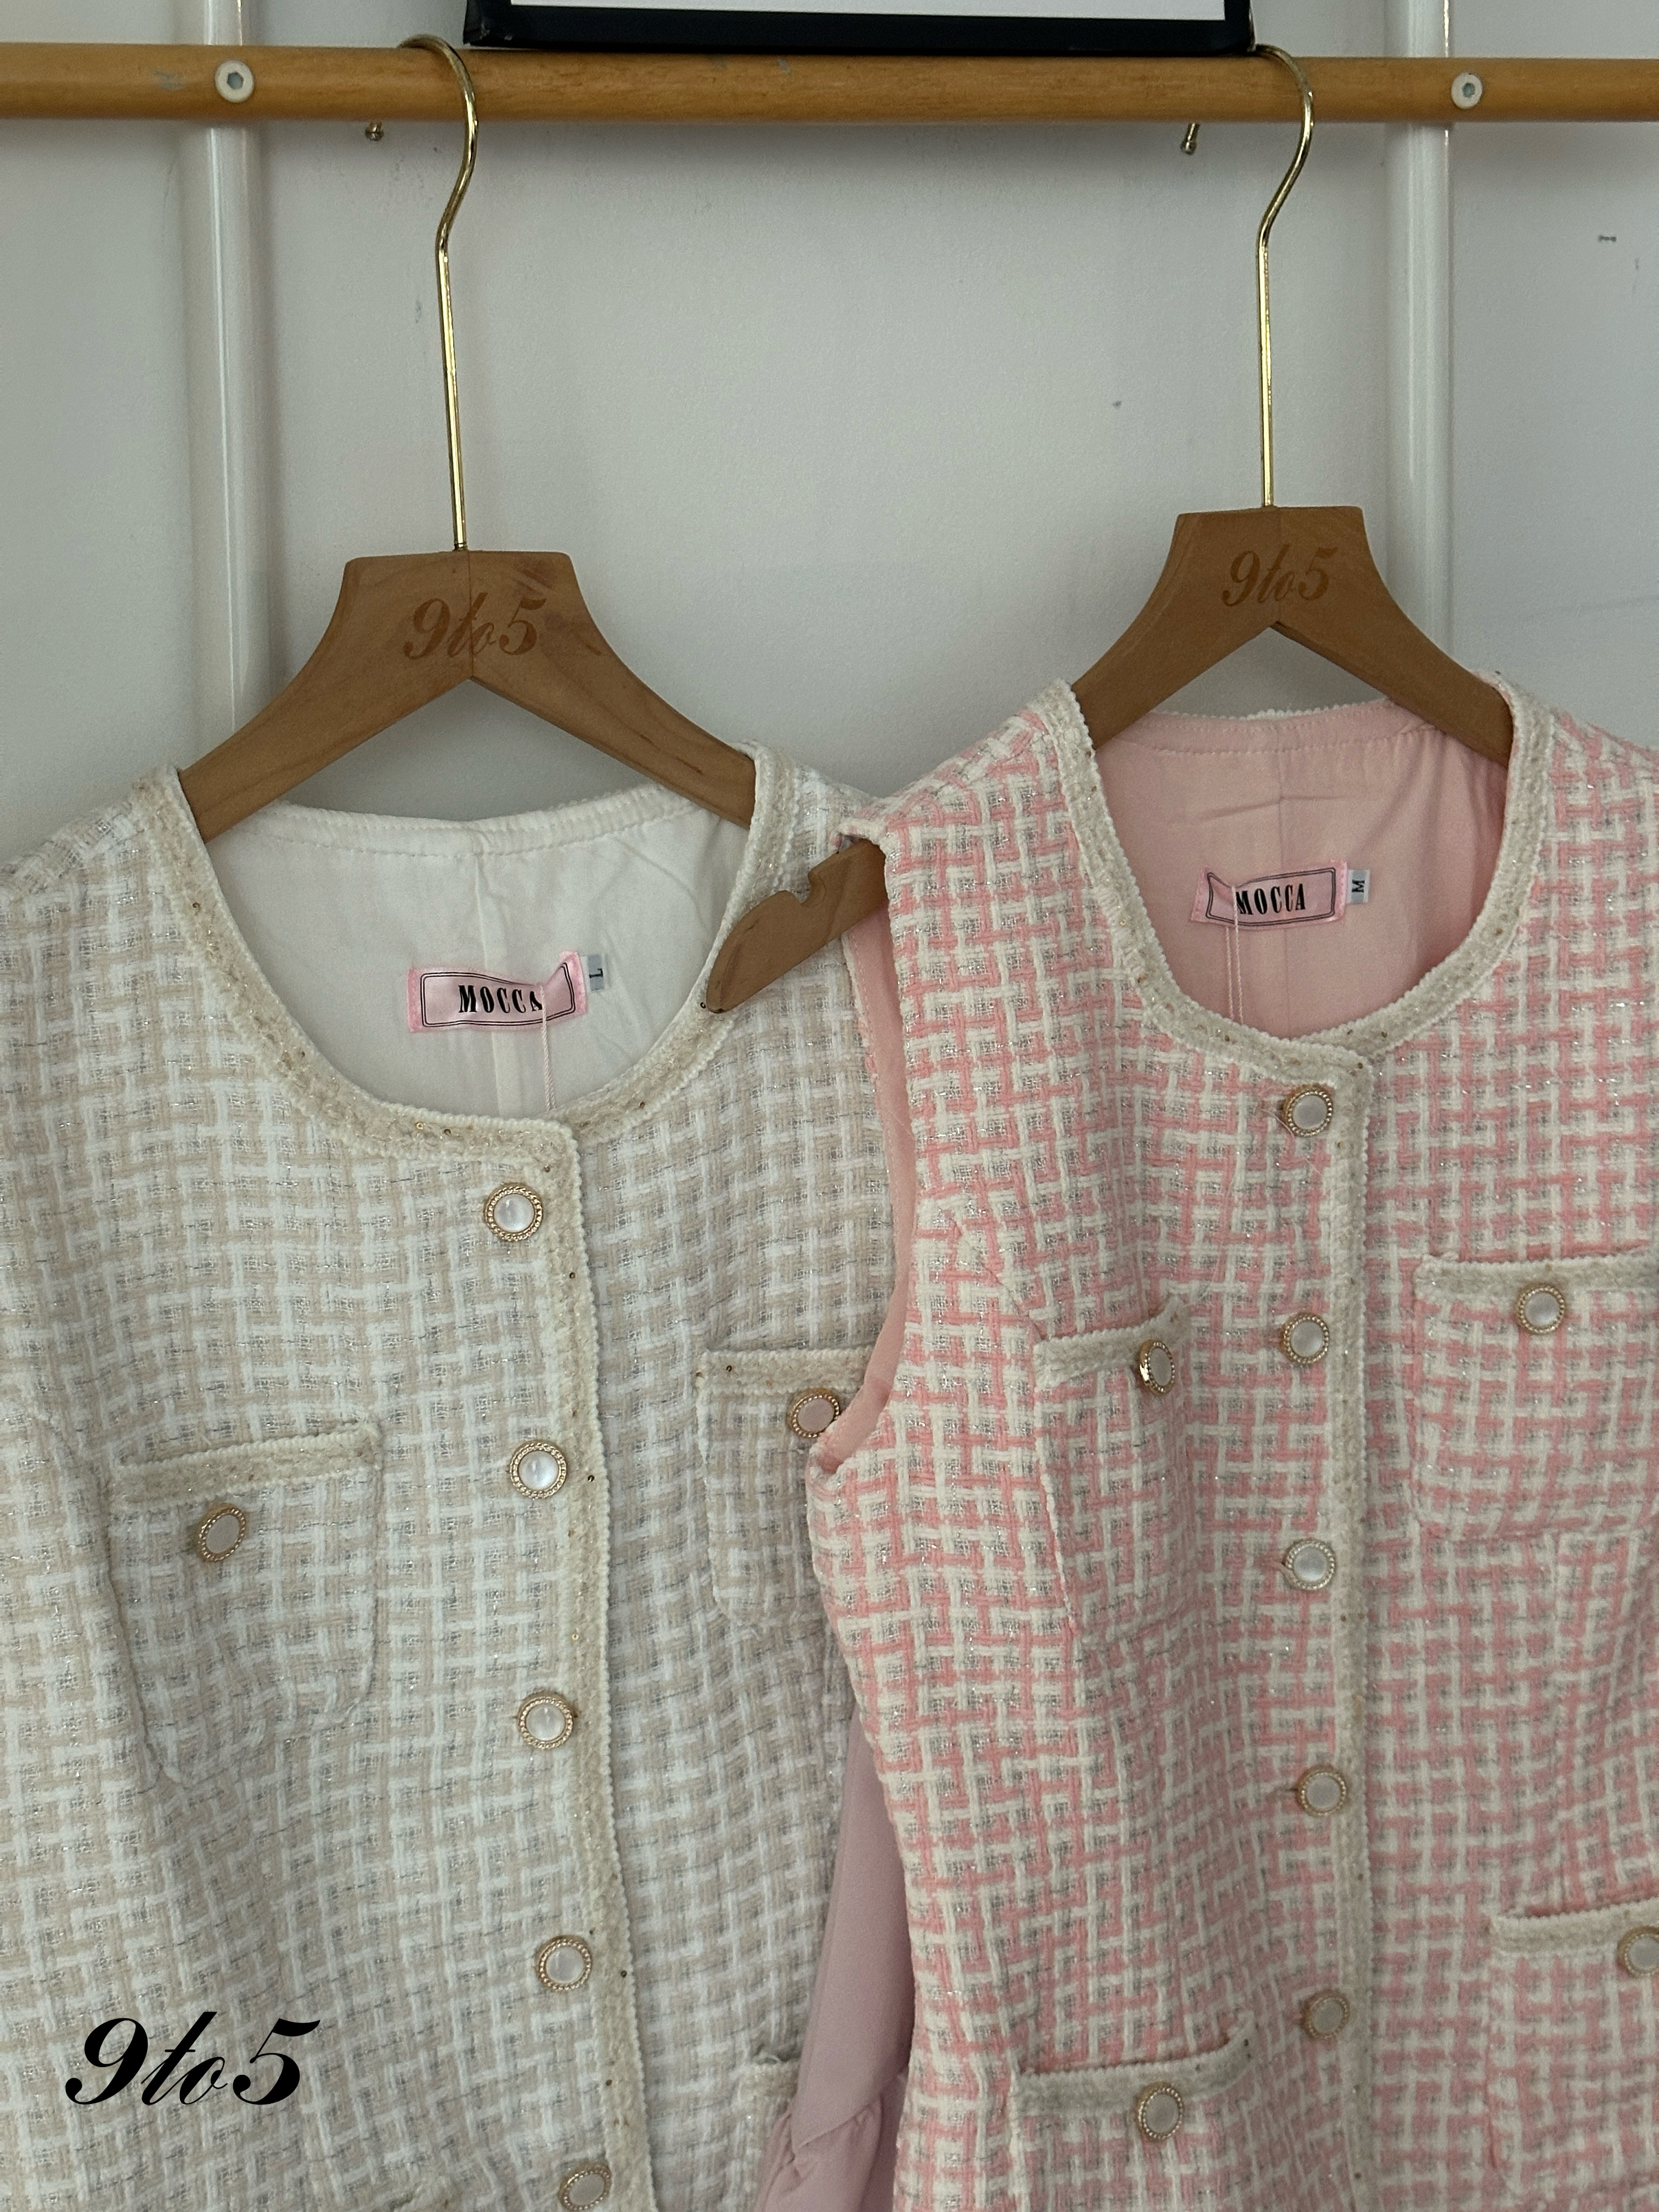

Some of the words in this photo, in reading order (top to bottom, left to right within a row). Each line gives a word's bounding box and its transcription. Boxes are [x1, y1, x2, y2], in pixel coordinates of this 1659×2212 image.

[1221, 543, 1339, 607] 9to5
[403, 591, 548, 659] 9to5
[1234, 883, 1306, 915] MOCCA
[1351, 879, 1365, 893] M
[589, 968, 603, 979] L
[458, 985, 543, 1014] MOCCA
